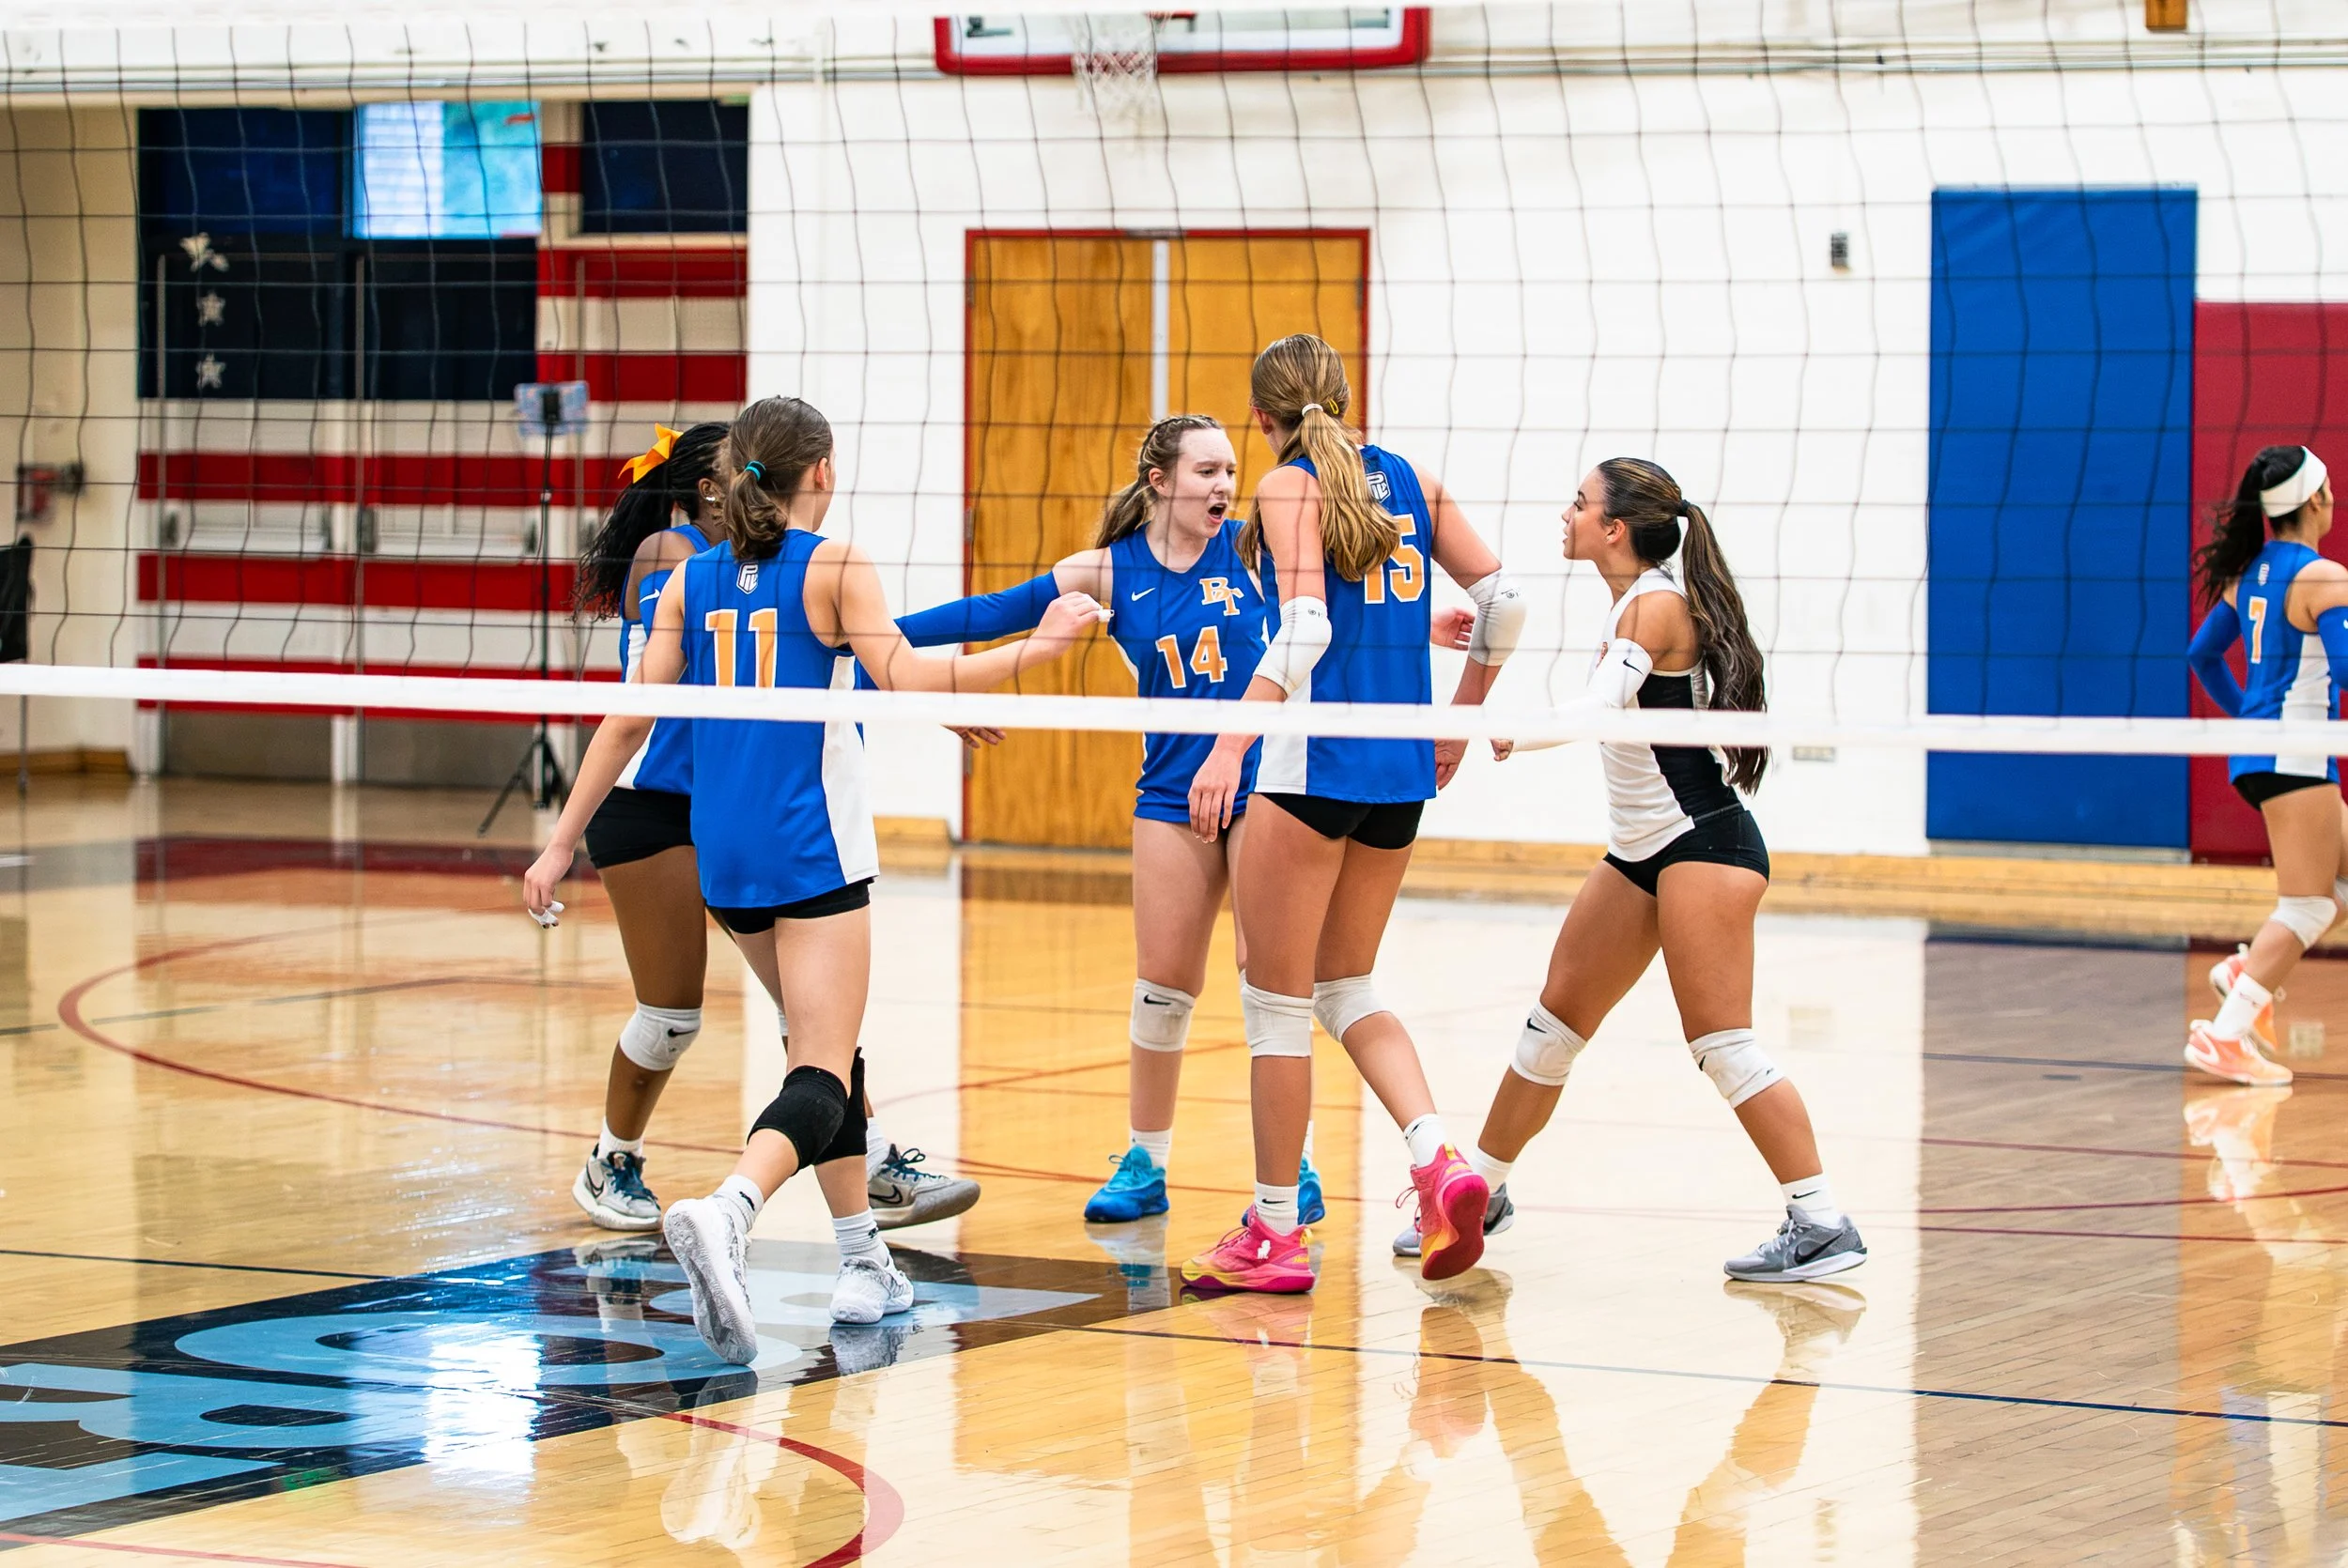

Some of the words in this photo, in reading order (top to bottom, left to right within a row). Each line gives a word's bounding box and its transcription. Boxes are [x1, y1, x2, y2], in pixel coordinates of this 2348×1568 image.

[704, 607, 778, 688] 11
[1155, 625, 1228, 689] 14
[2248, 595, 2268, 664] 7
